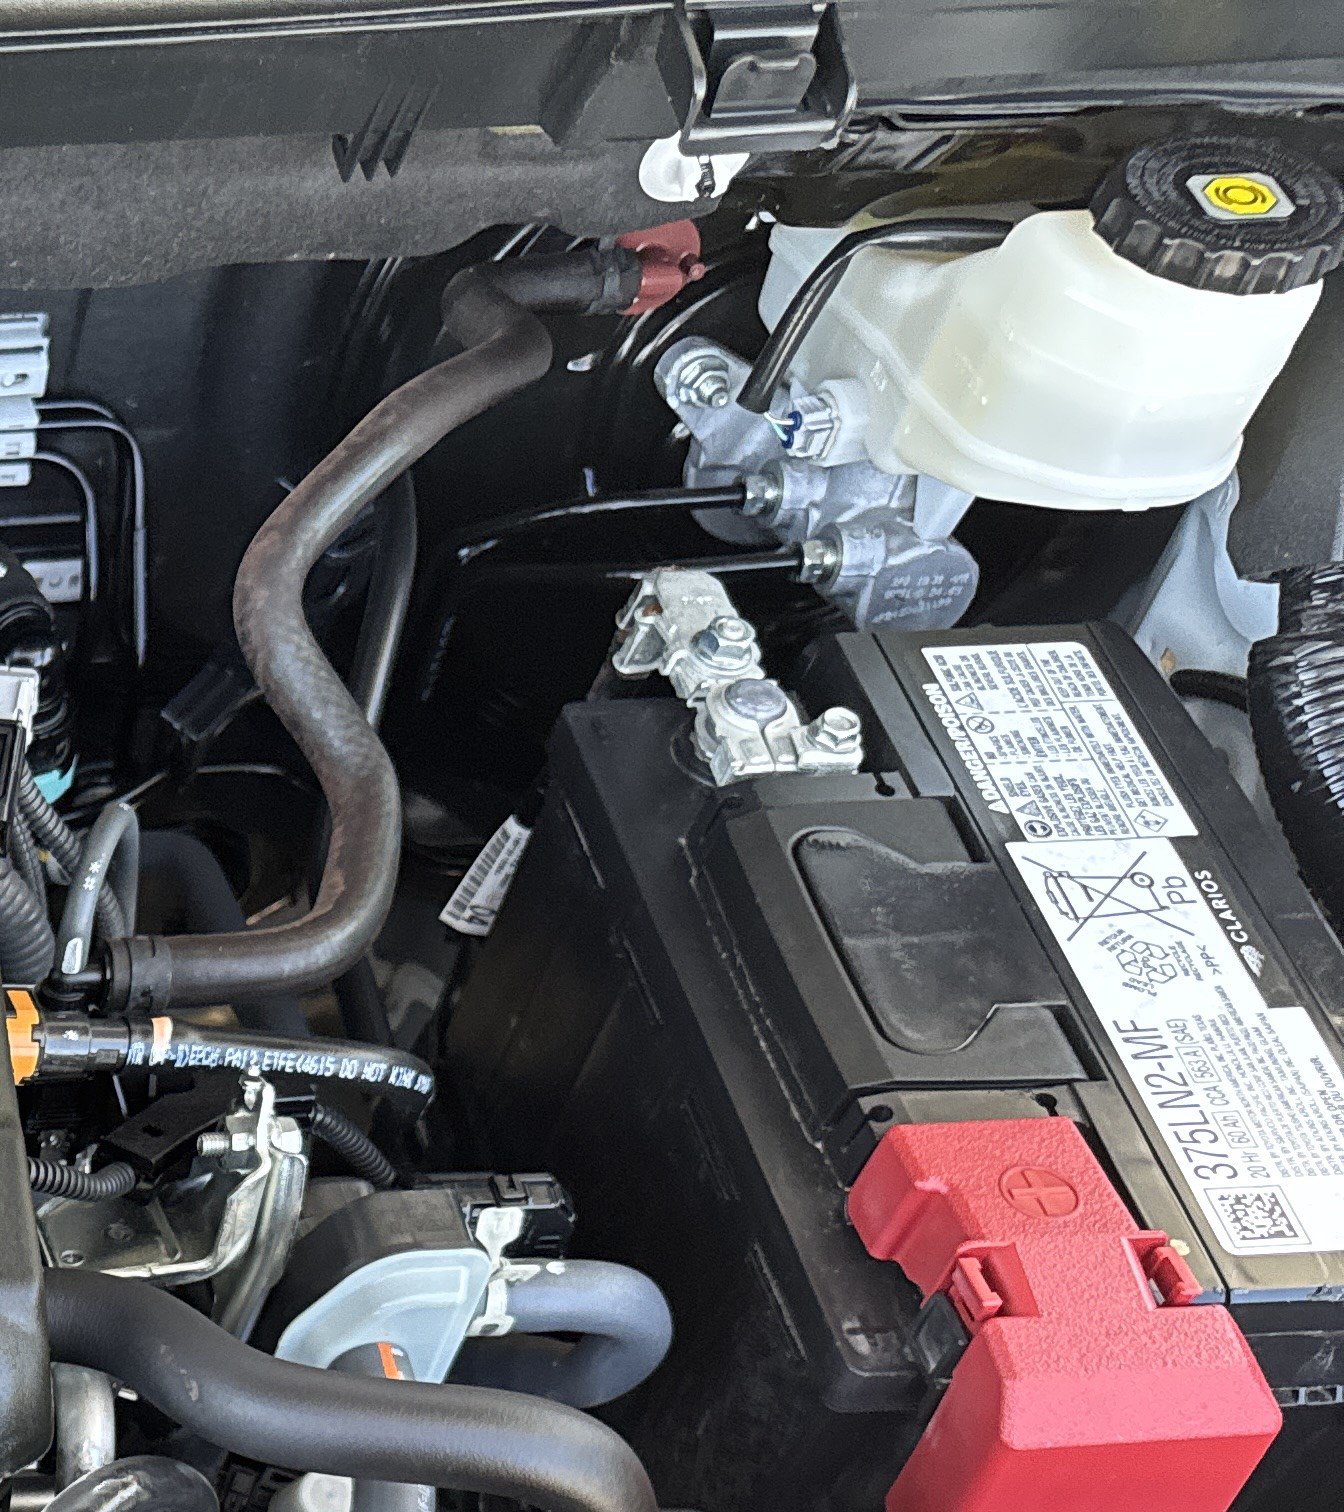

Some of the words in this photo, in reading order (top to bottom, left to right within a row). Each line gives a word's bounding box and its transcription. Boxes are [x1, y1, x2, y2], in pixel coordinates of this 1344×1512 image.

[1162, 876, 1197, 904] Pb
[1194, 870, 1248, 943] CLARIOS
[1163, 1018, 1200, 1044] (SAE)
[1185, 1059, 1216, 1079] 563
[1112, 1020, 1241, 1179] 375LN2-MF
[1199, 1084, 1232, 1106] CCA
[1216, 1115, 1244, 1128] Ah
[1225, 1131, 1252, 1143] 60
[1236, 1151, 1263, 1162] Hr
[1244, 1165, 1271, 1178] 20
